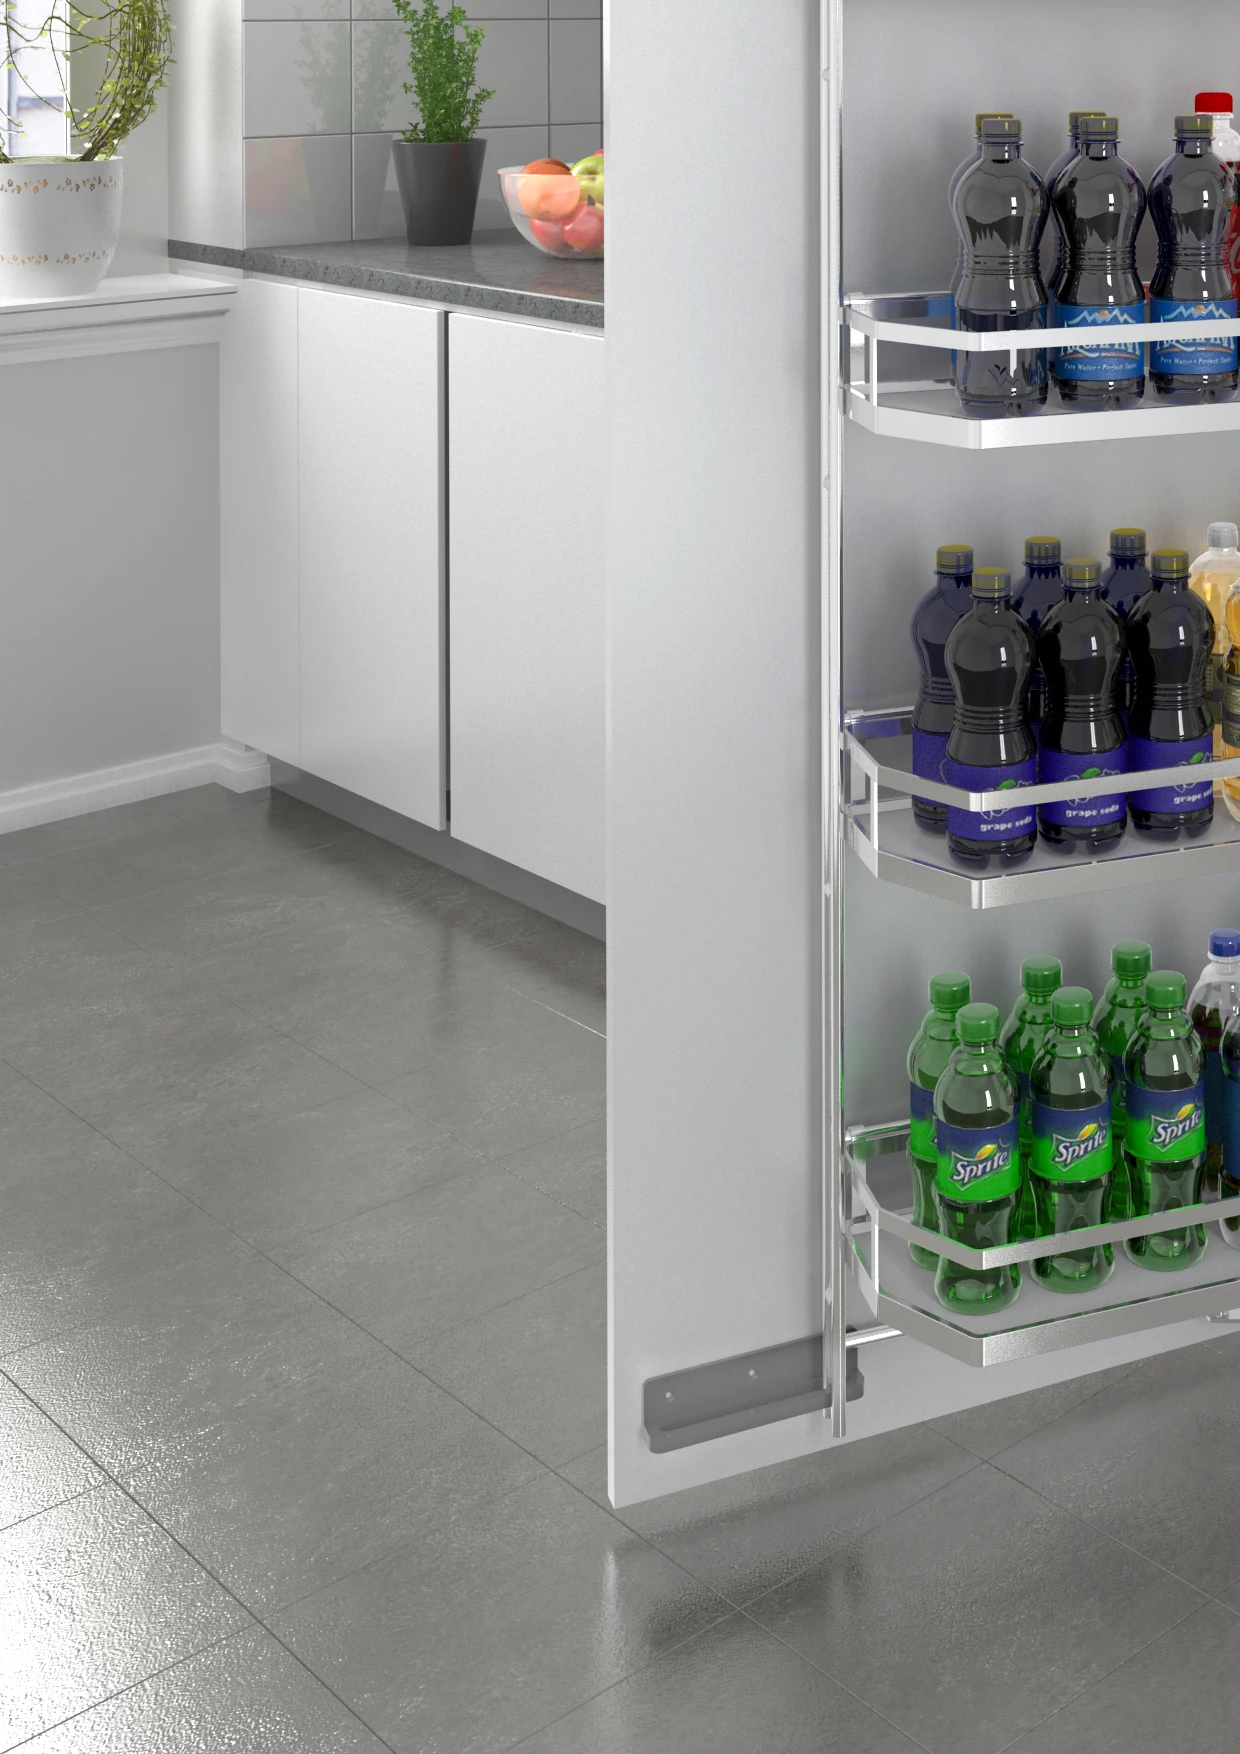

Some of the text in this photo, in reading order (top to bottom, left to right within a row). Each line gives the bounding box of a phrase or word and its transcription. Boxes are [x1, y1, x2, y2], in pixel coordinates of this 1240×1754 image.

[1066, 803, 1119, 819] grape soda
[1174, 794, 1201, 805] grape
[980, 816, 1033, 832] grape soda
[1152, 1109, 1202, 1144] Sprite
[1053, 1128, 1107, 1163] Sprite
[951, 1150, 1008, 1184] Sprite
